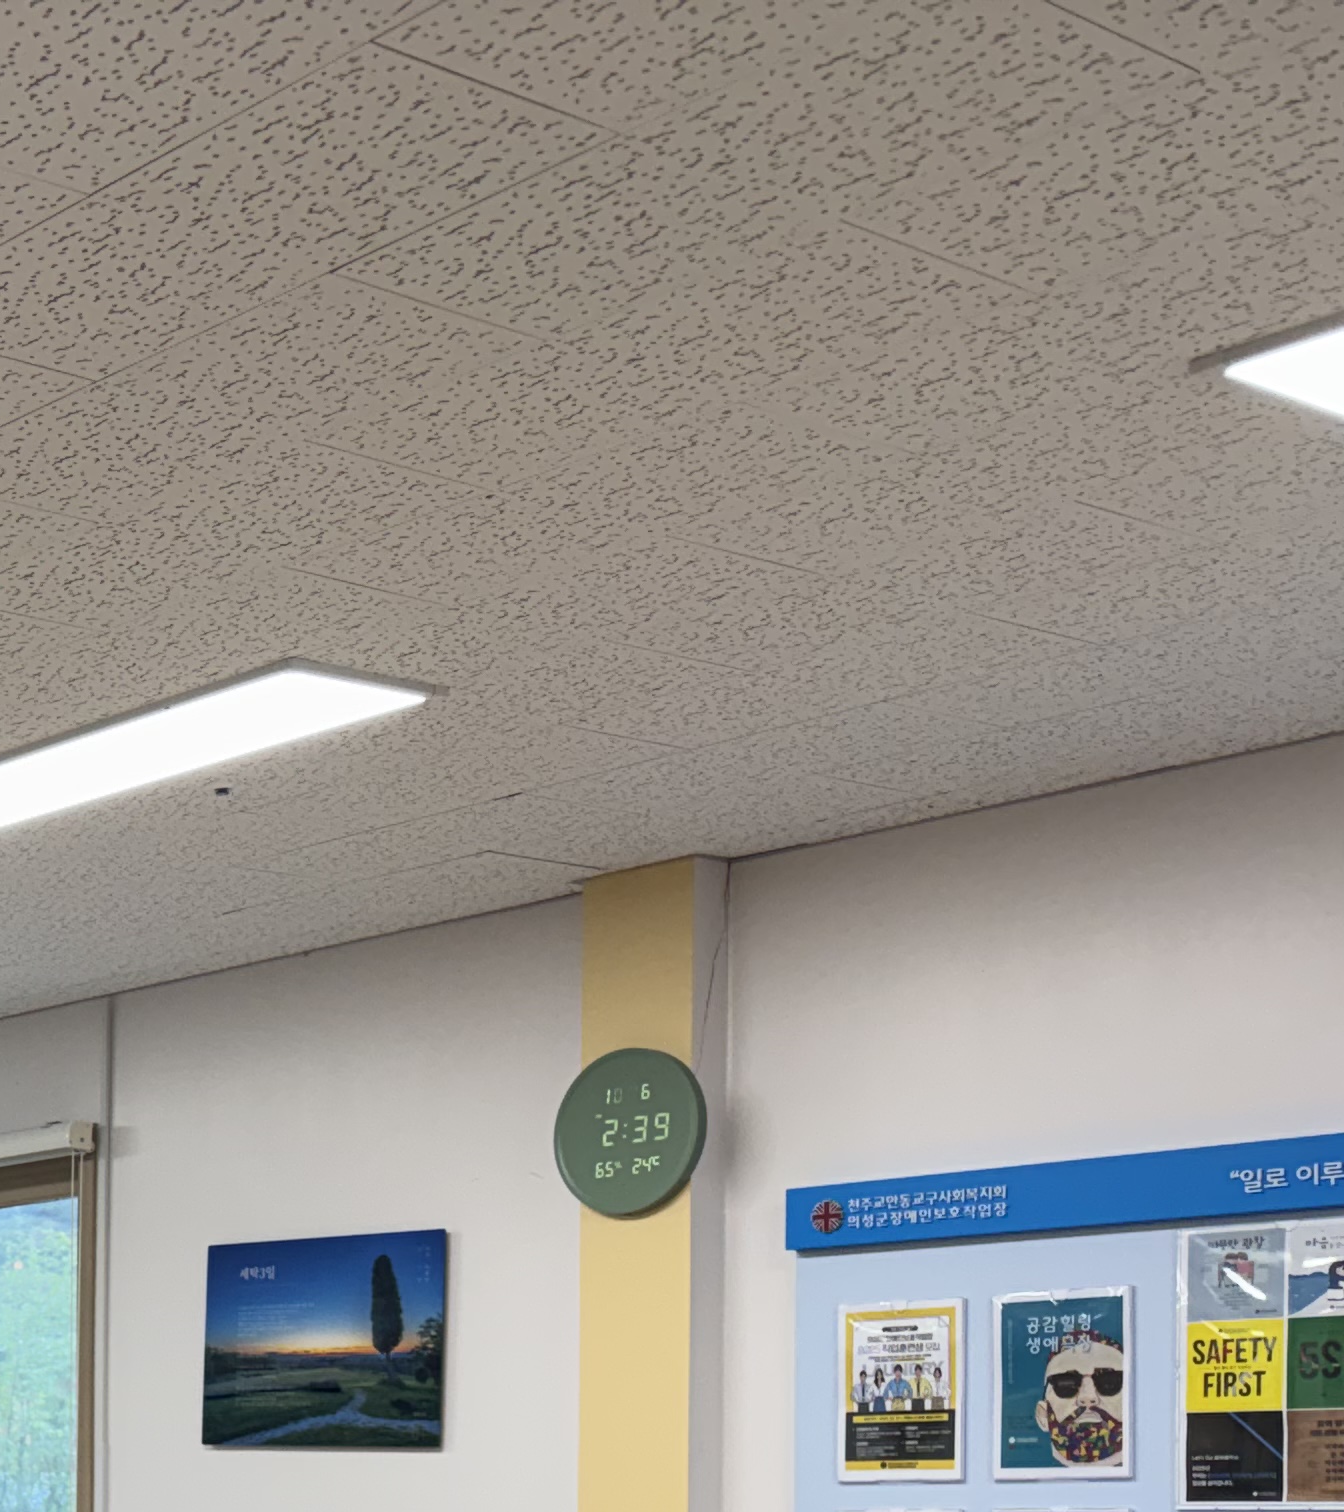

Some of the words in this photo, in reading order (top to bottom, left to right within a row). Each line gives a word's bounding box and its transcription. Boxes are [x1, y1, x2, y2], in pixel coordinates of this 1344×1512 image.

[602, 1112, 670, 1147] 2:39
[847, 1185, 1007, 1212] 천주교안동교구사회복지회
[847, 1201, 1007, 1229] 의성군장애인보호작업장
[1192, 1336, 1277, 1364] SAFETY
[1299, 1340, 1341, 1380] 5S
[1203, 1371, 1266, 1398] FIRST
